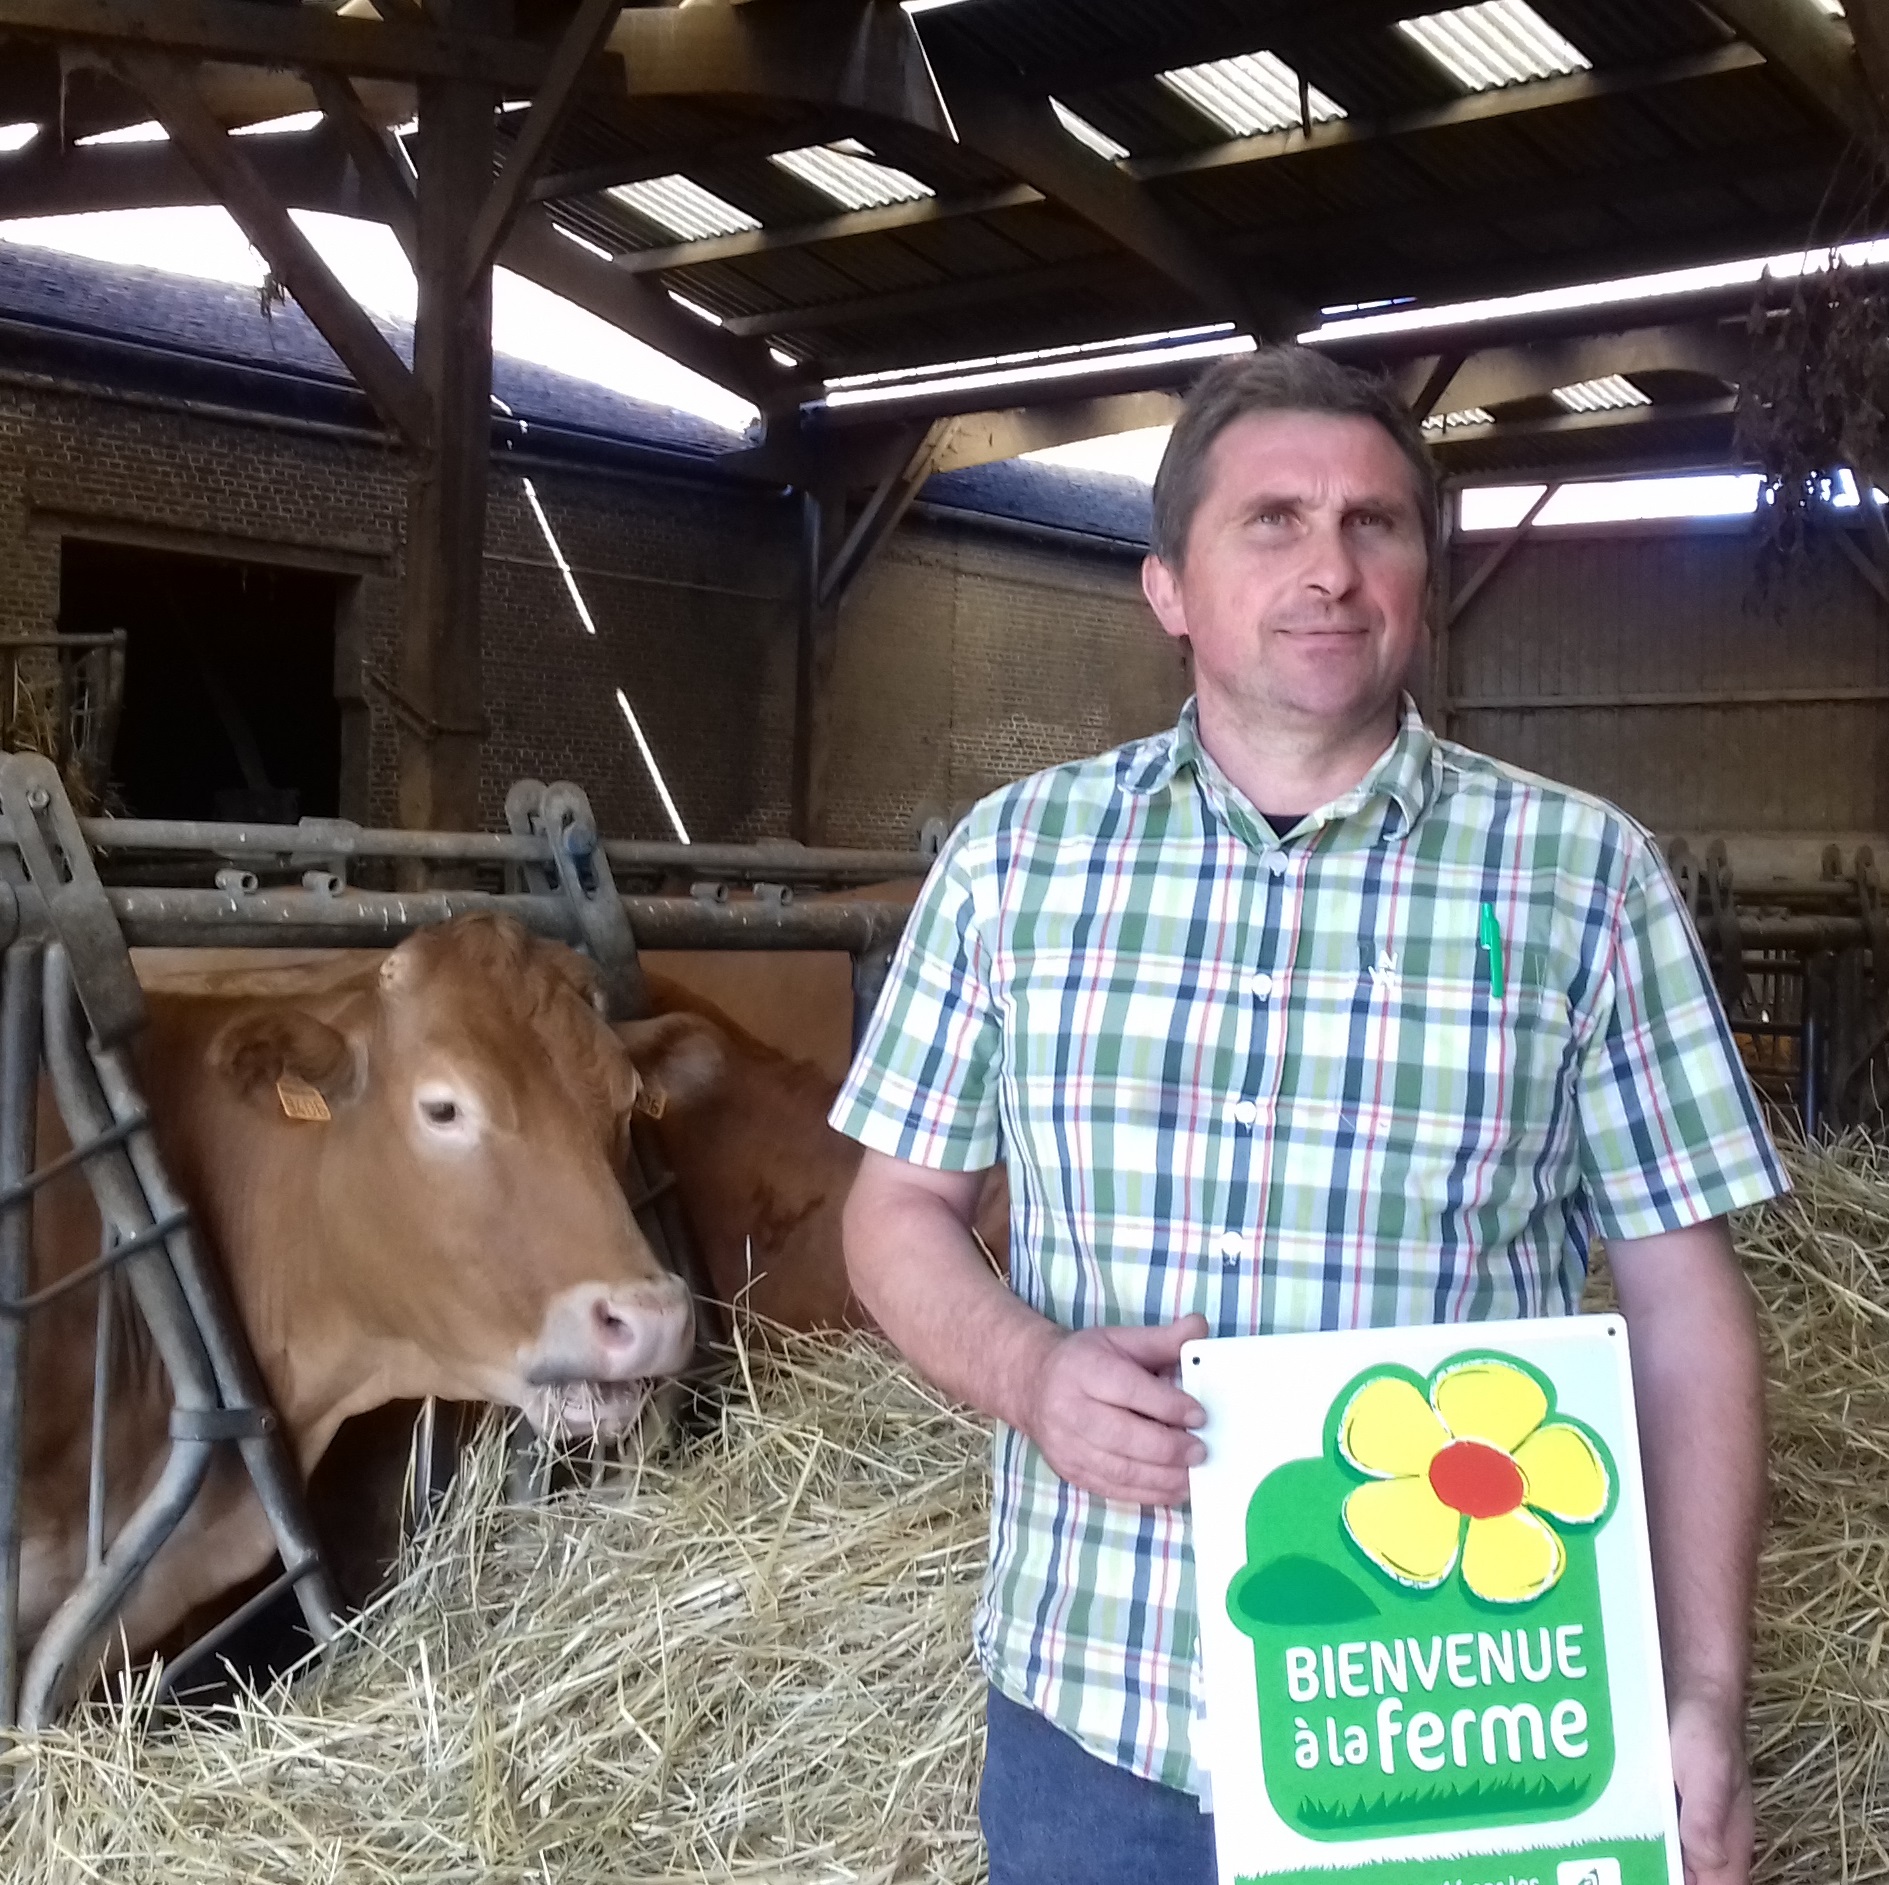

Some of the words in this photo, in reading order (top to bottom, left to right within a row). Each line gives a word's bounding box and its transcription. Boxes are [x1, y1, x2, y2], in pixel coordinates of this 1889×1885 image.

[1286, 1624, 1588, 1702] BIENVENUE
[1294, 1717, 1320, 1769] à
[1326, 1716, 1369, 1767] la
[1376, 1697, 1589, 1774] ferme
